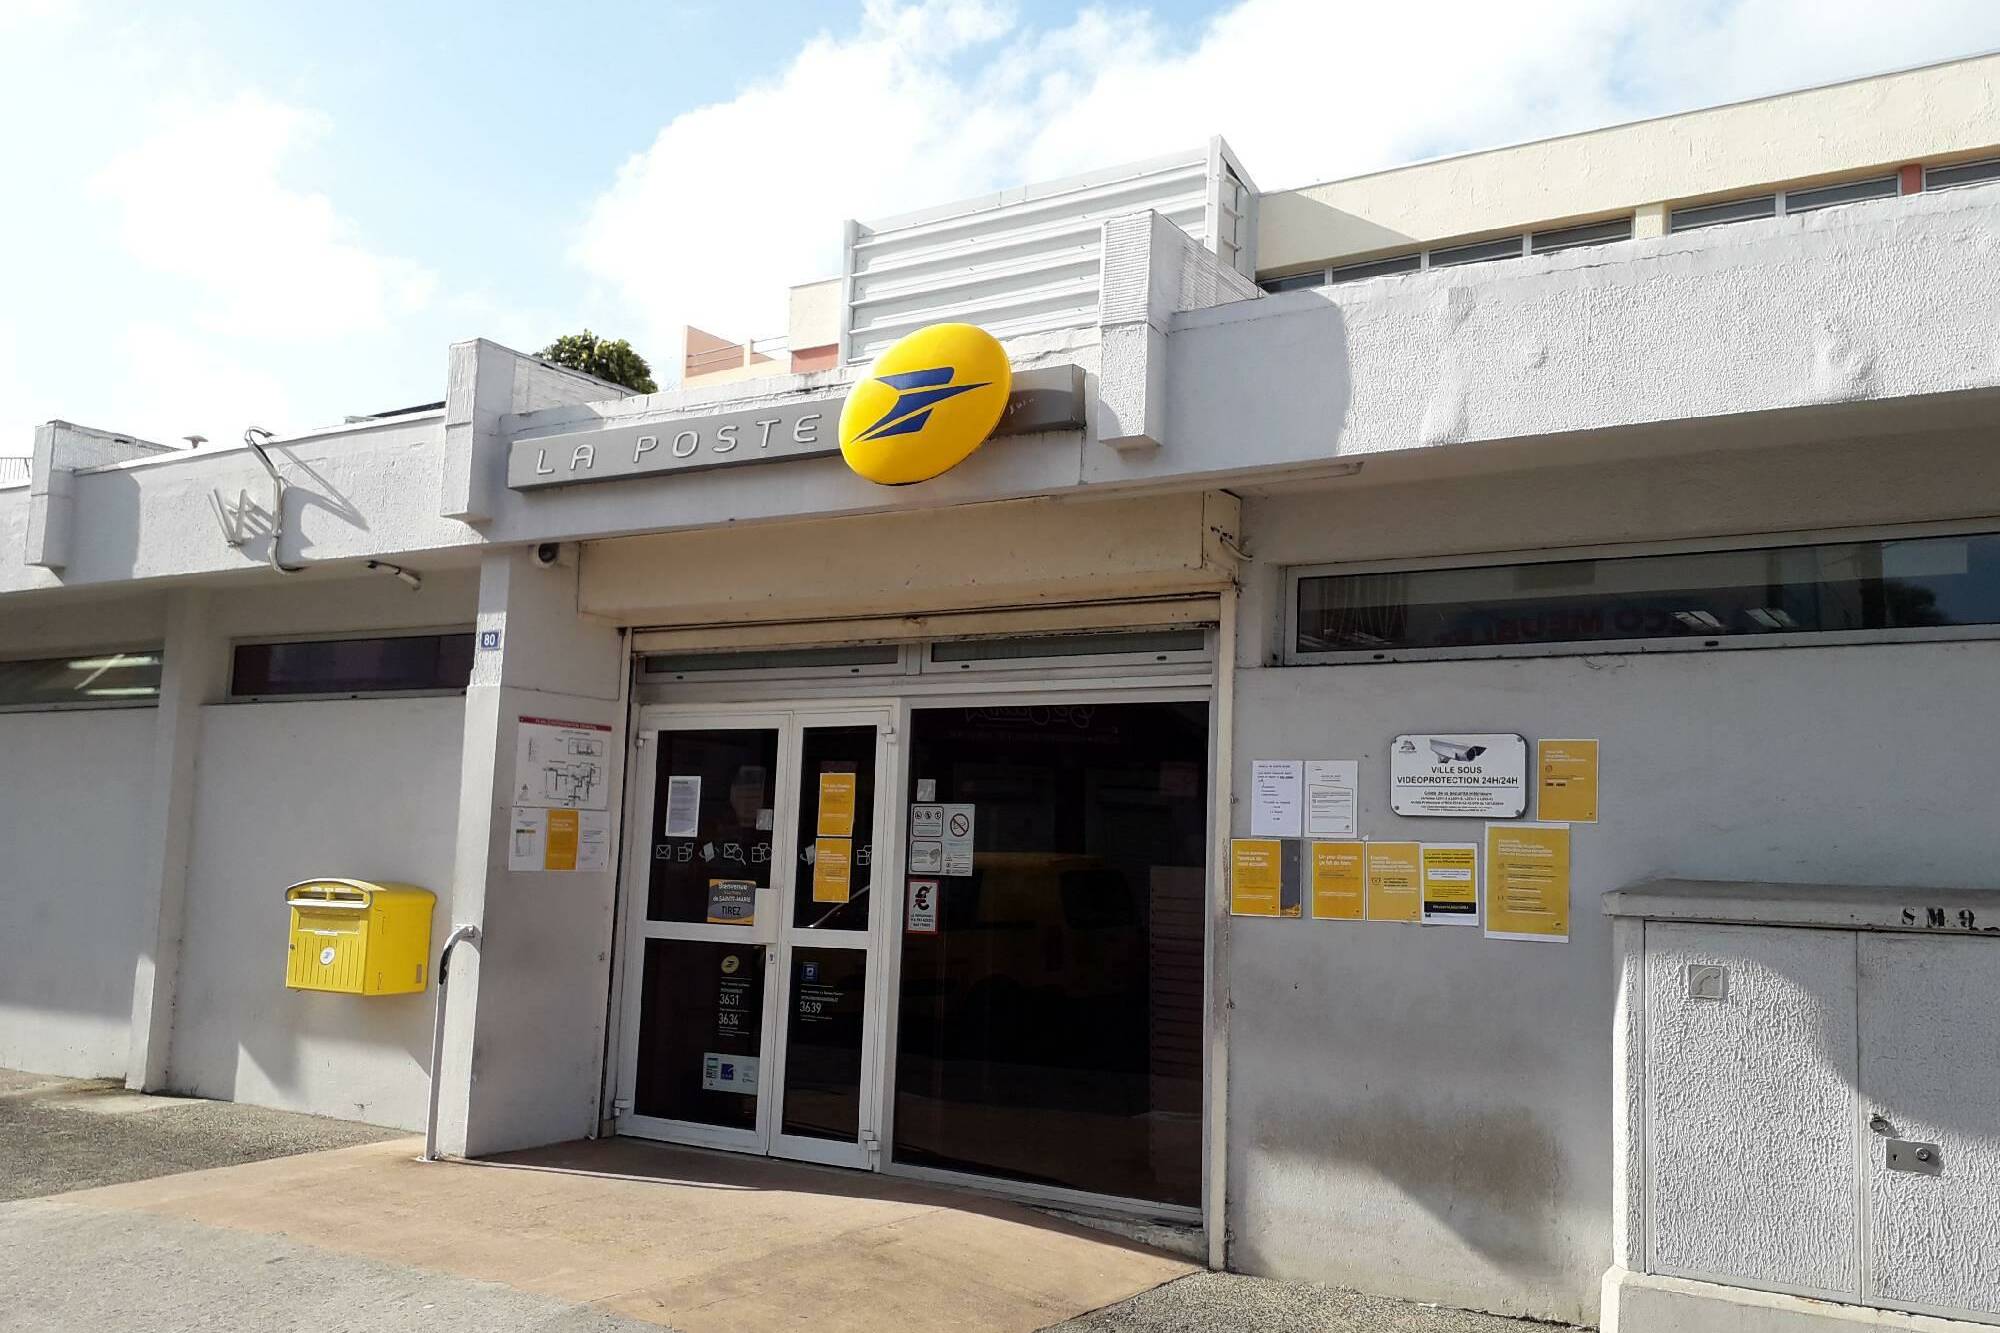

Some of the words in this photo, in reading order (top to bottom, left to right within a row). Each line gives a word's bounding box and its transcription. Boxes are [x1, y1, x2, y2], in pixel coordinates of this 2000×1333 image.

[536, 443, 596, 475] LA
[633, 413, 823, 464] POSTE
[484, 633, 496, 646] 80
[1431, 766, 1455, 774] VILLE
[1457, 766, 1483, 774] SOUS
[1481, 776, 1519, 785] 24H/24H
[722, 906, 741, 916] TIREZ
[719, 993, 739, 1006] 3631
[799, 1000, 822, 1014] 3639
[718, 1013, 739, 1025] 3634
